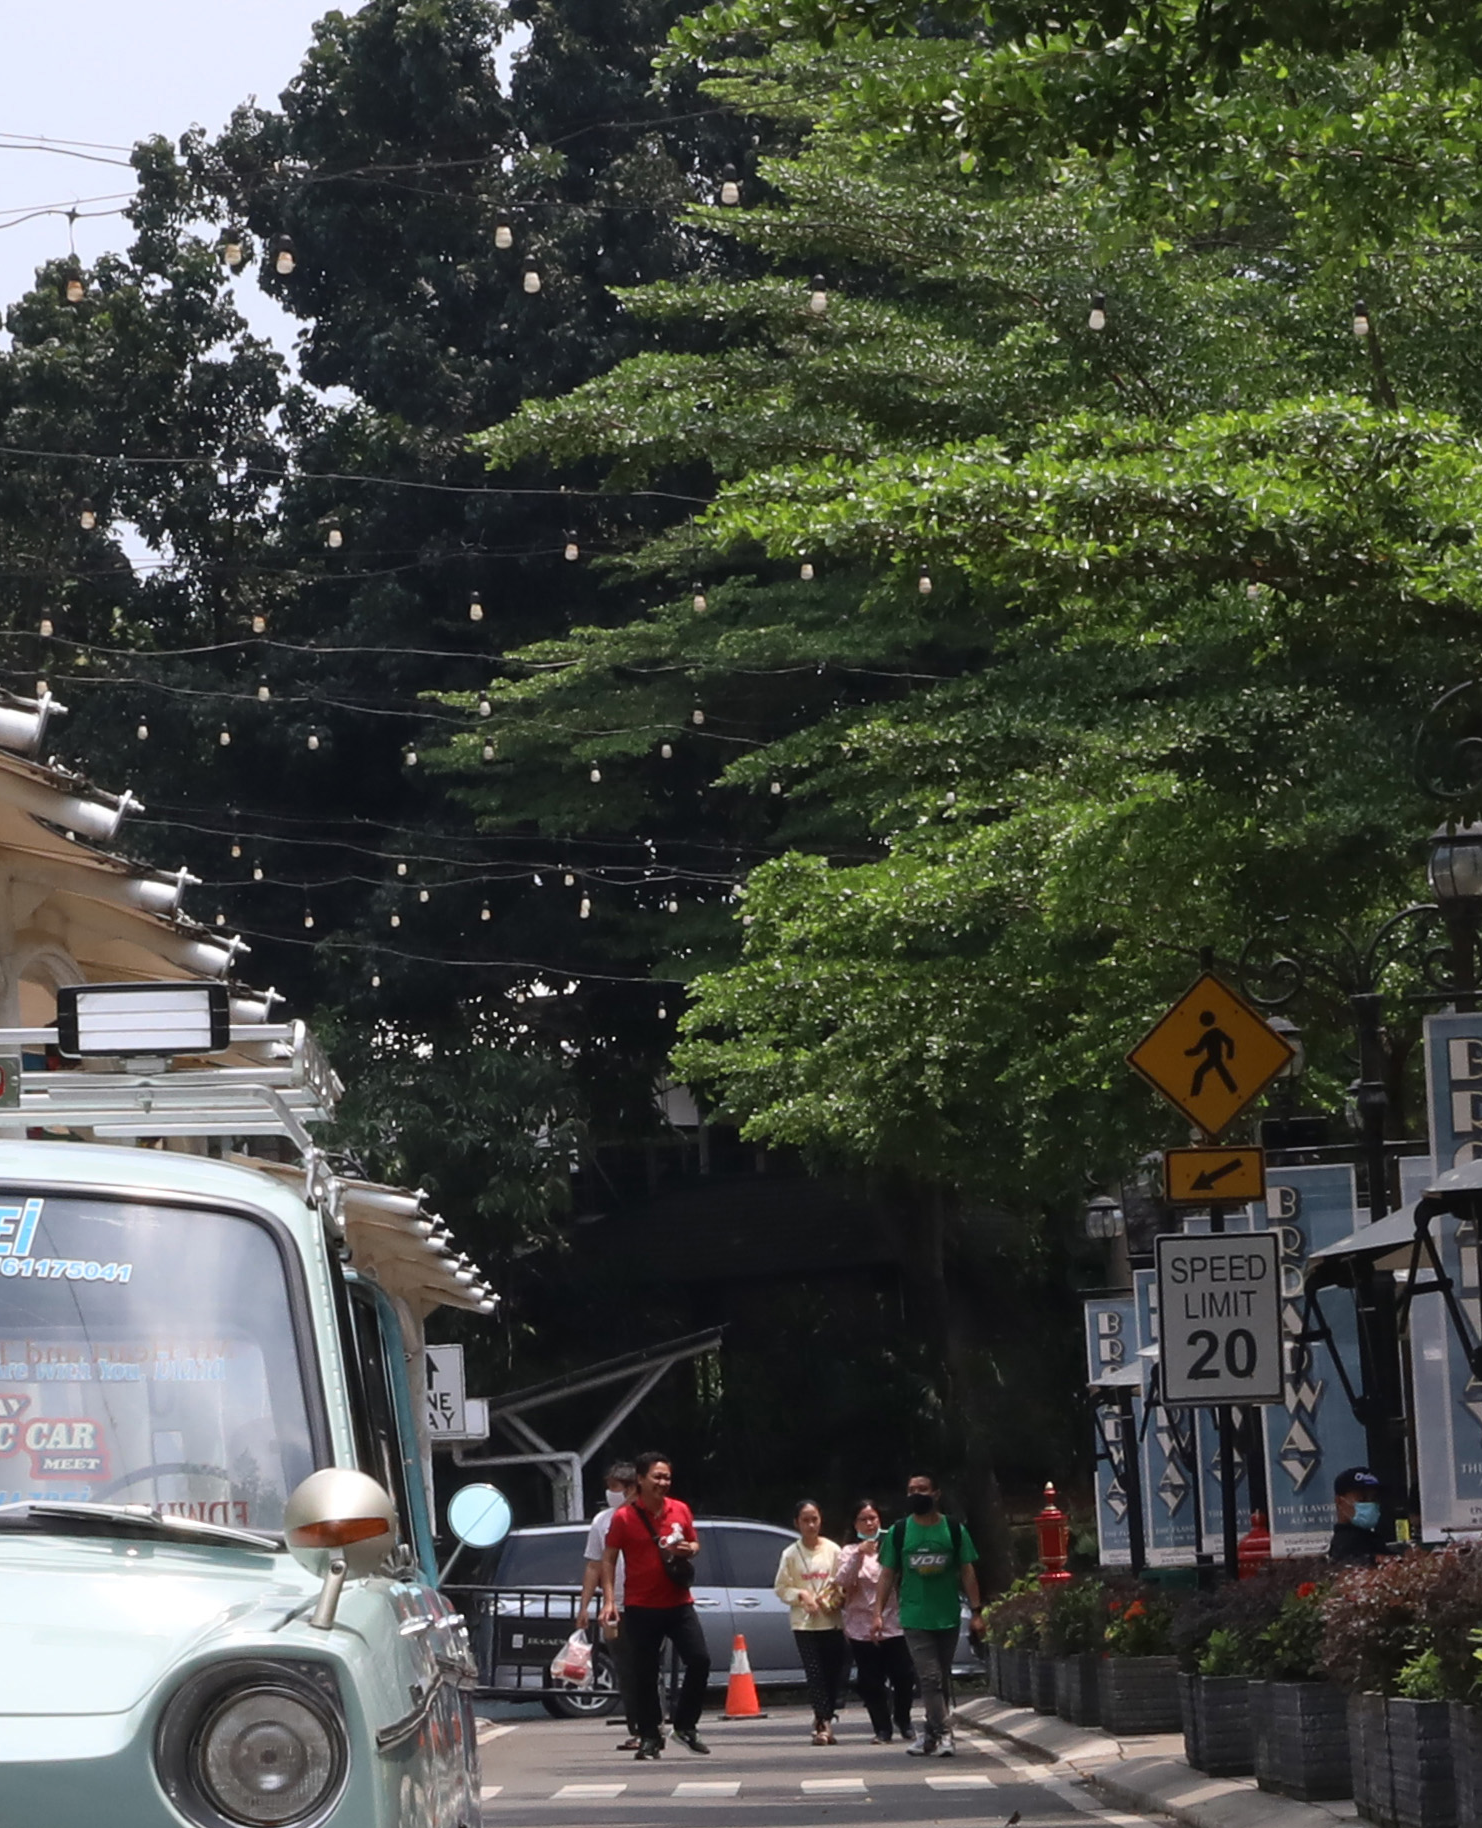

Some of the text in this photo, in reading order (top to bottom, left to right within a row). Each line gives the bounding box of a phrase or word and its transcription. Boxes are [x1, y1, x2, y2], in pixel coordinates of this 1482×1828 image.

[1170, 1254, 1266, 1284] SPEED
[1184, 1290, 1257, 1319] LIMIT
[1187, 1328, 1257, 1380] 20
[427, 1392, 452, 1411] NE
[428, 1411, 455, 1430] AY
[25, 1421, 97, 1451] CAR
[43, 1458, 101, 1470] MEET
